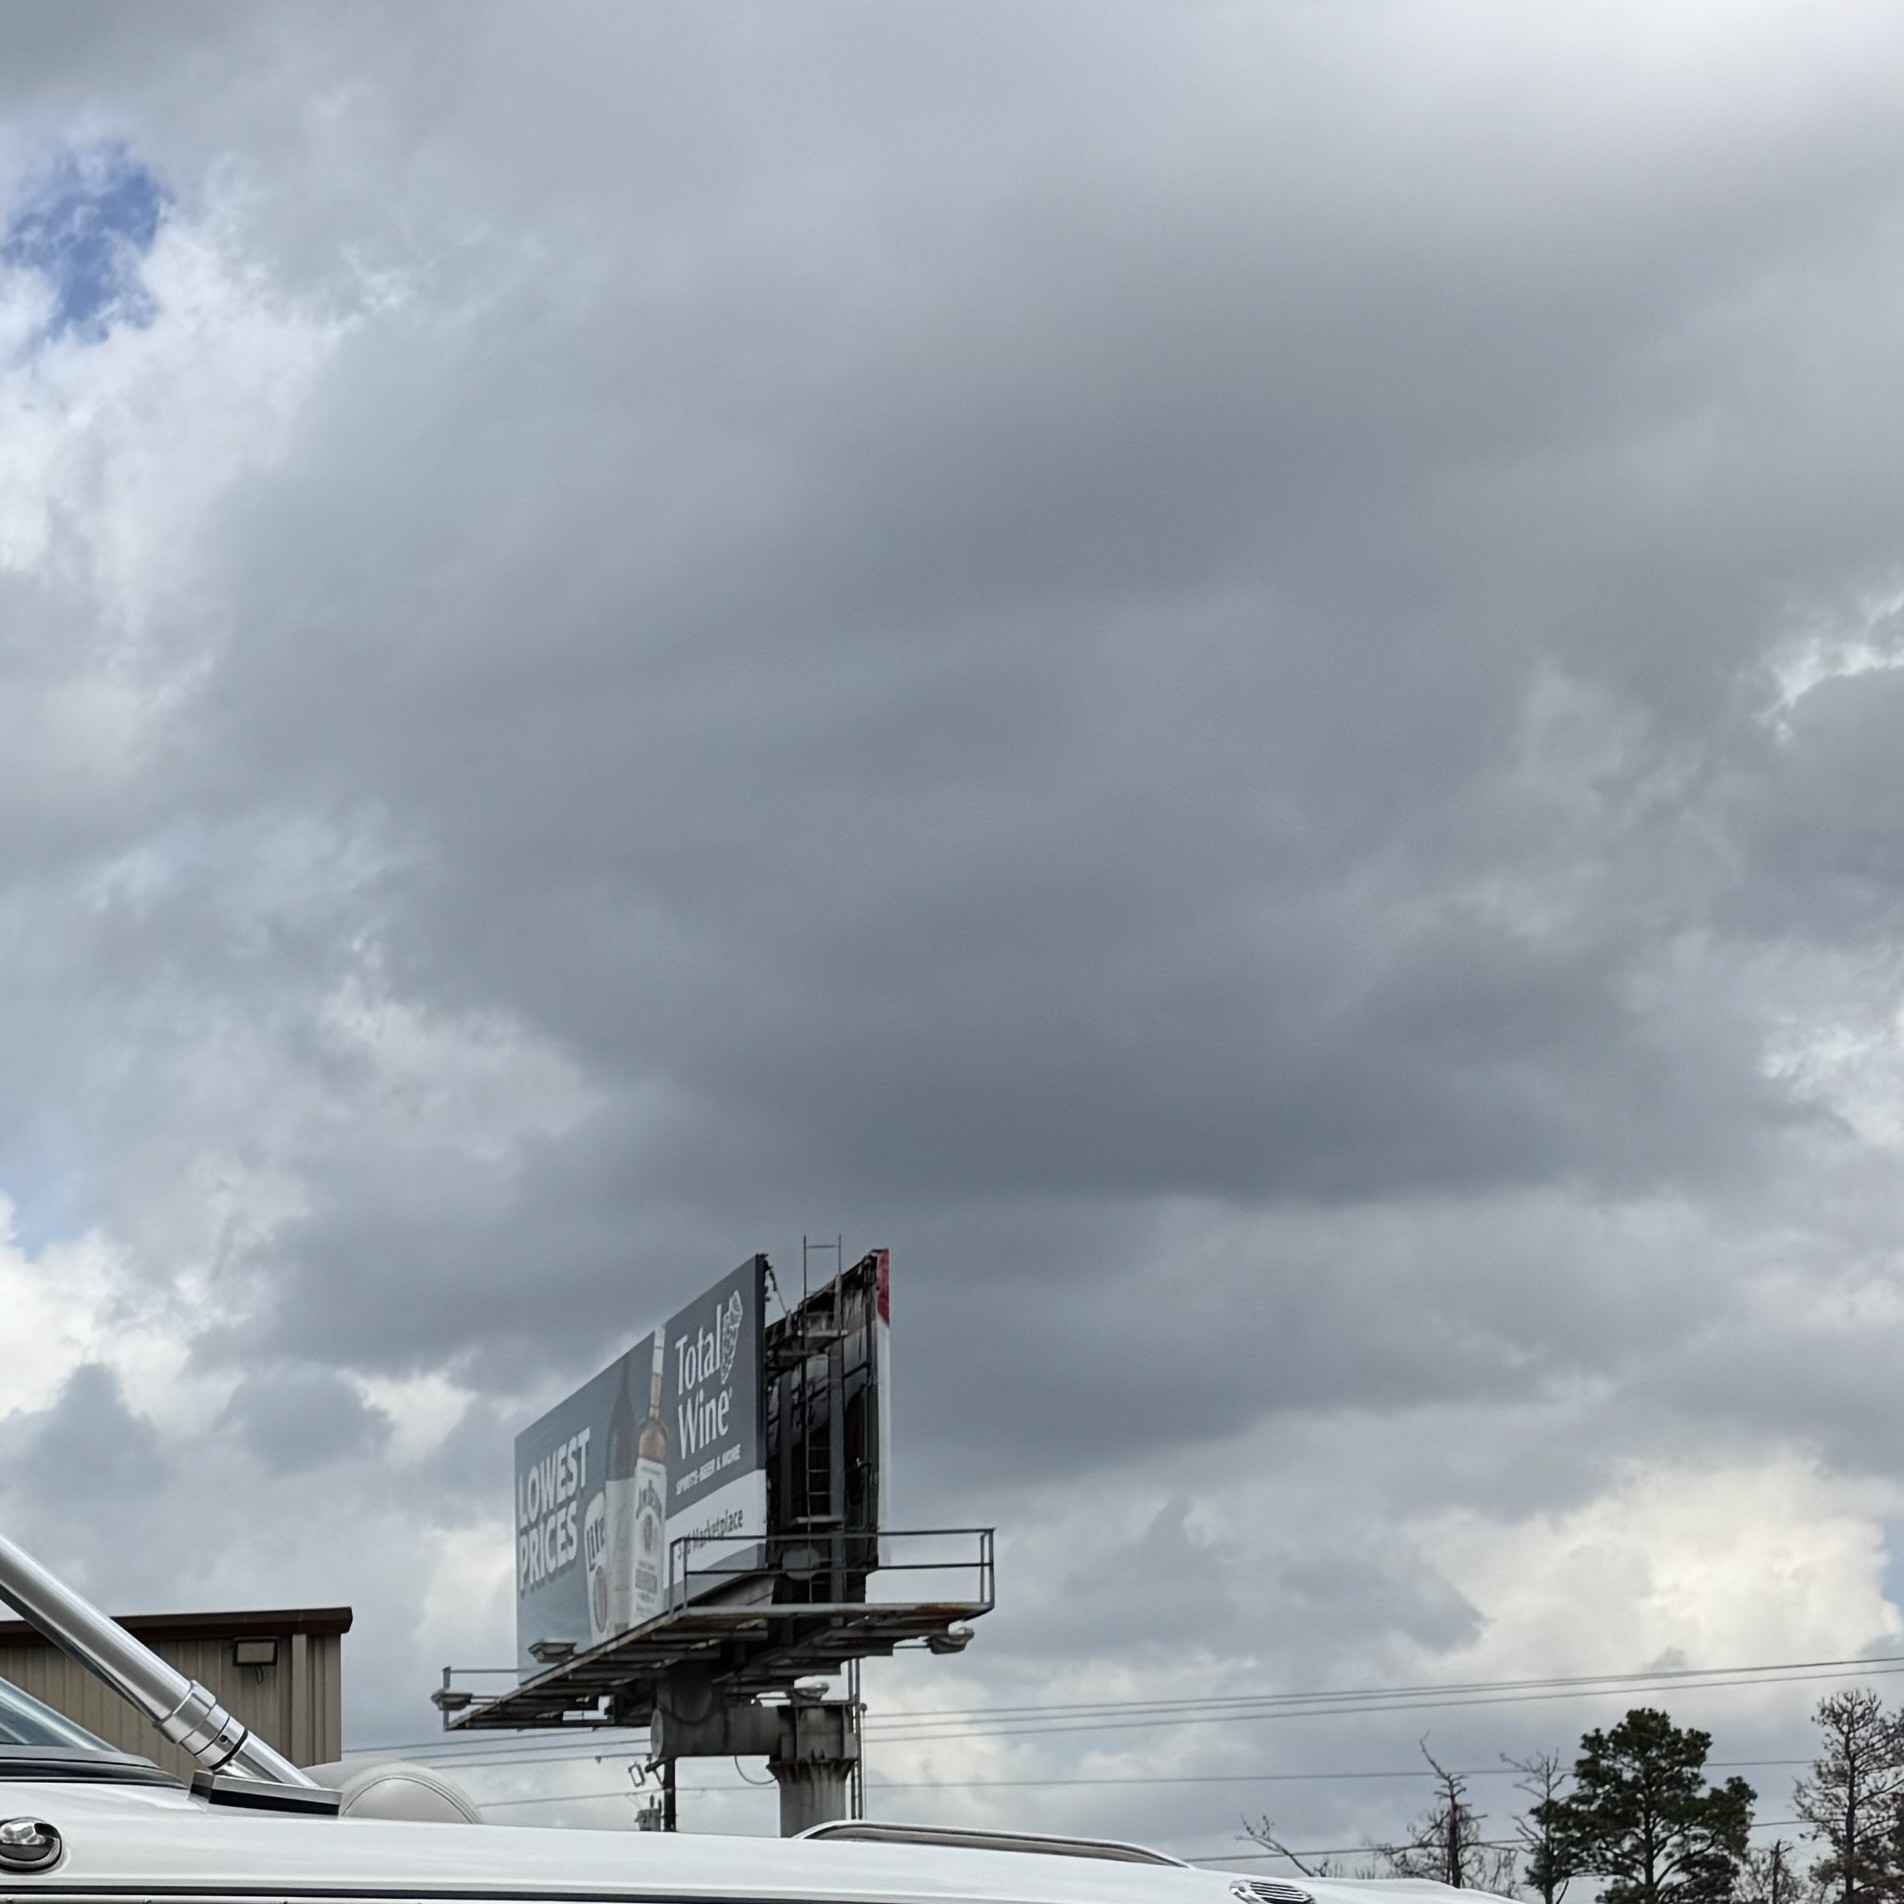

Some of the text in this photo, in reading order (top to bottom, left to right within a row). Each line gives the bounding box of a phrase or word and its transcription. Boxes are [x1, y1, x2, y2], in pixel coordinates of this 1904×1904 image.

[675, 1304, 722, 1396] Total
[678, 1388, 730, 1460] Wine
[519, 1427, 591, 1528] LOWEST
[519, 1501, 578, 1592] PRICES
